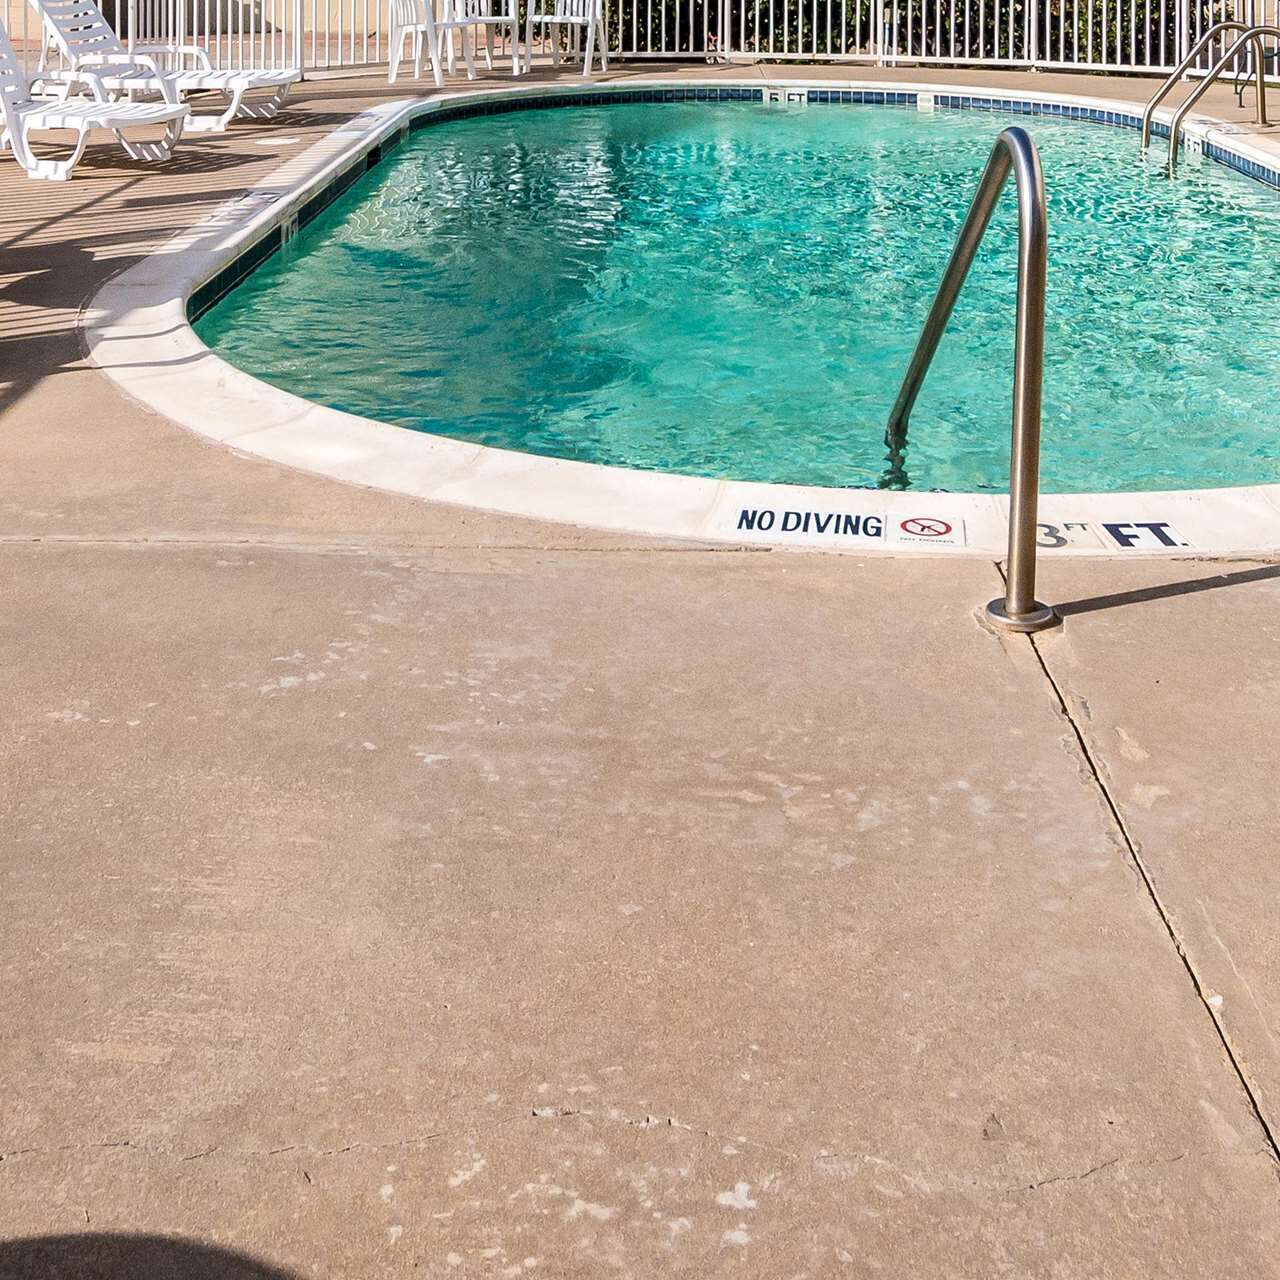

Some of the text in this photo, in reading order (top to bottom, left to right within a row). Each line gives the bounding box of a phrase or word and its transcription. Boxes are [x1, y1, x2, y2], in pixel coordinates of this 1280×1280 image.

[786, 92, 806, 105] FT
[736, 509, 884, 538] NO DIVING
[1101, 522, 1189, 548] FT.
